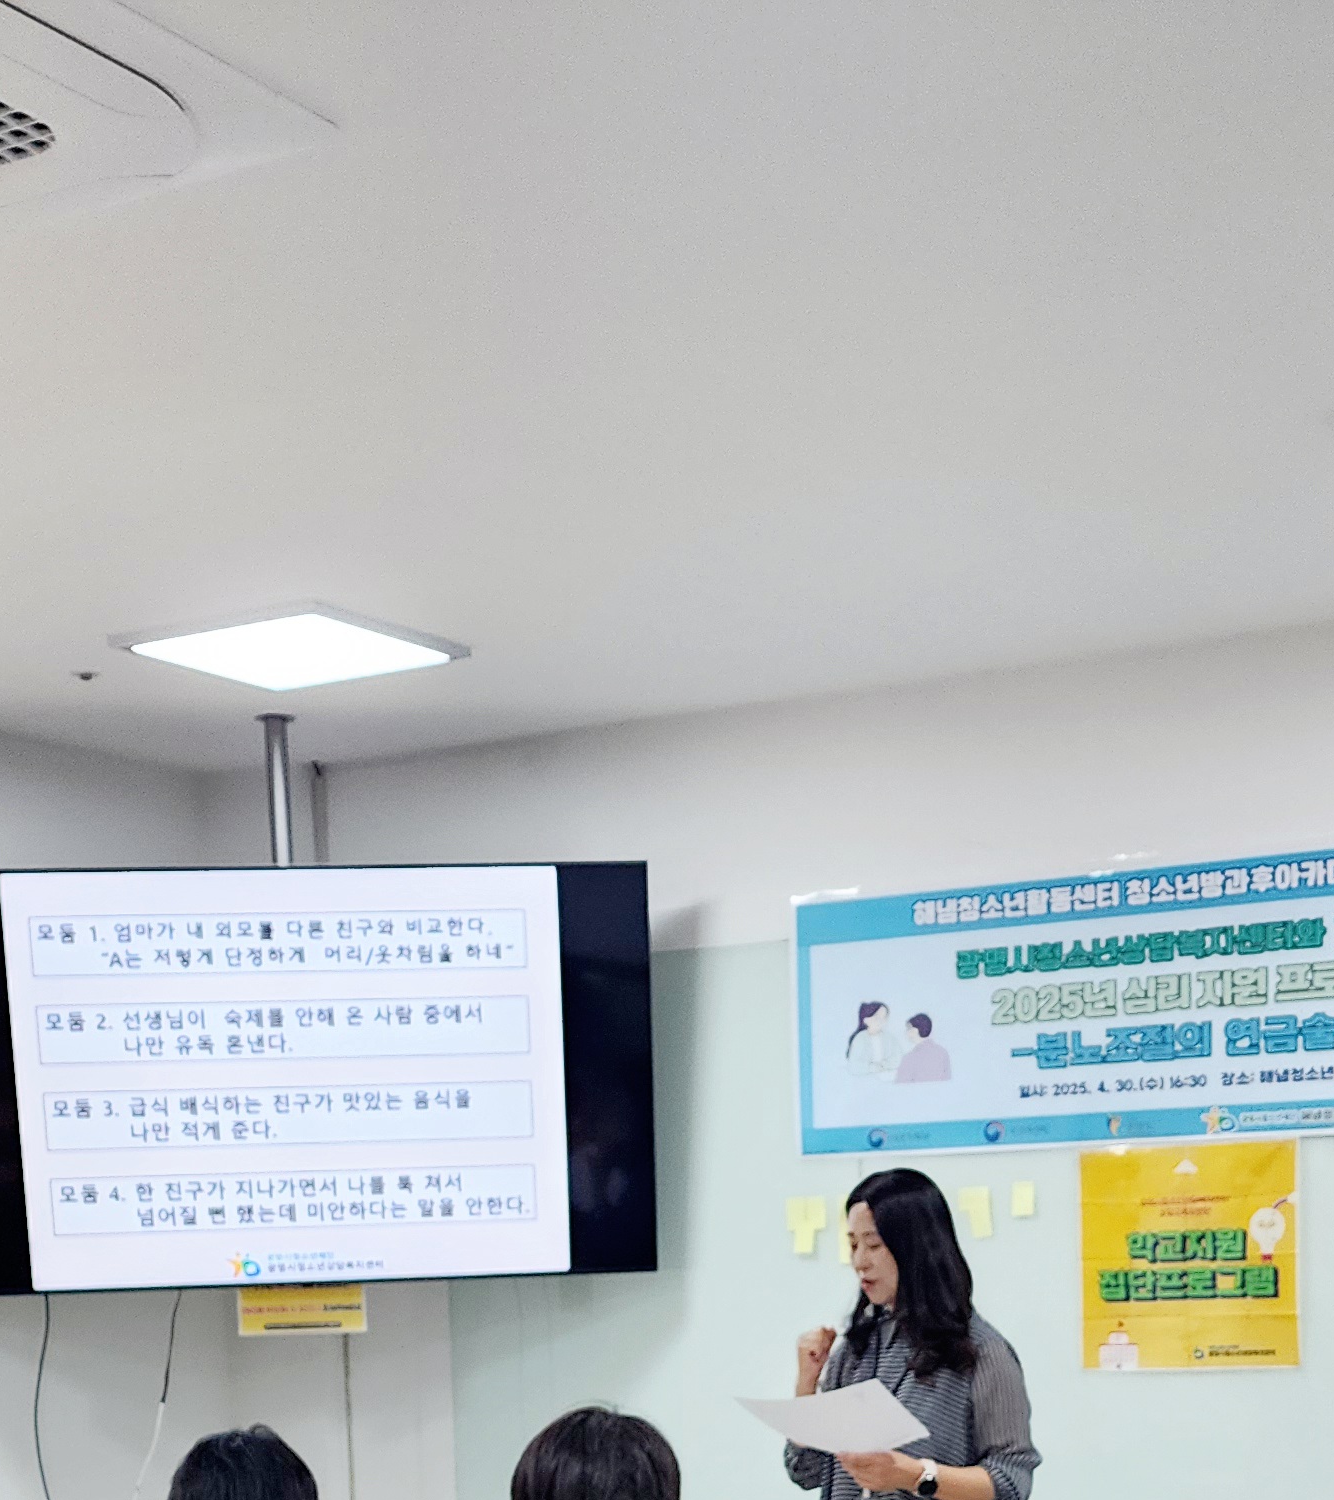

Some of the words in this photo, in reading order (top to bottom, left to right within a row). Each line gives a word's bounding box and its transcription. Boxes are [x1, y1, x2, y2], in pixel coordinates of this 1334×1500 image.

[912, 881, 1121, 926] 해남청소년활동센터
[38, 922, 75, 944] 모둠
[89, 925, 105, 942] 1.
[114, 922, 175, 943] 엄마가
[187, 921, 204, 939] 내
[216, 921, 275, 941] 외모를
[287, 920, 324, 940] 다른
[337, 919, 394, 939] 친구와
[154, 947, 214, 968] 저렇게
[225, 946, 305, 968] 단정하게
[325, 945, 453, 966] 머리/옷차림을
[991, 979, 1117, 1026] 2025년
[1123, 971, 1191, 1016] 심리
[1196, 966, 1269, 1008] 지원
[46, 1013, 85, 1032] 모둠
[95, 1013, 113, 1030] 2.
[123, 1009, 206, 1030] 선생님이
[225, 1008, 283, 1028] 숙제를
[295, 1007, 336, 1027] 안해
[347, 1006, 364, 1026] 온
[374, 1004, 413, 1025] 사람
[424, 1003, 483, 1025] 중에서
[124, 1035, 164, 1056] 나만
[176, 1035, 214, 1055] 유독
[226, 1033, 293, 1054] 혼낸다.
[1053, 1081, 1091, 1096] 2025.
[1221, 1072, 1255, 1086] 장소:
[53, 1099, 91, 1119] 모둠
[103, 1100, 120, 1117] 3.
[129, 1097, 168, 1117] 급식
[180, 1094, 262, 1115] 배식하는
[273, 1093, 334, 1114] 친구가
[343, 1091, 403, 1112] 맛있는
[414, 1088, 471, 1110] 음식을
[131, 1122, 170, 1143] 나만
[182, 1120, 220, 1141] 적게
[232, 1119, 278, 1140] 준다.
[60, 1184, 98, 1204] 모둠
[109, 1186, 126, 1202] 4.
[136, 1182, 154, 1202] 한
[165, 1180, 225, 1202] 친구가
[235, 1176, 338, 1199] 지나가면서
[348, 1175, 386, 1196] 나를
[138, 1206, 197, 1227] 넘어질
[208, 1206, 226, 1225] 뻔
[237, 1203, 297, 1224] 했는데
[307, 1200, 408, 1221] 미안하다는
[418, 1197, 455, 1218] 말을
[465, 1195, 531, 1216] 안한다.
[1126, 1228, 1247, 1264] 학교지원
[1099, 1263, 1279, 1304] 집단프로그램
